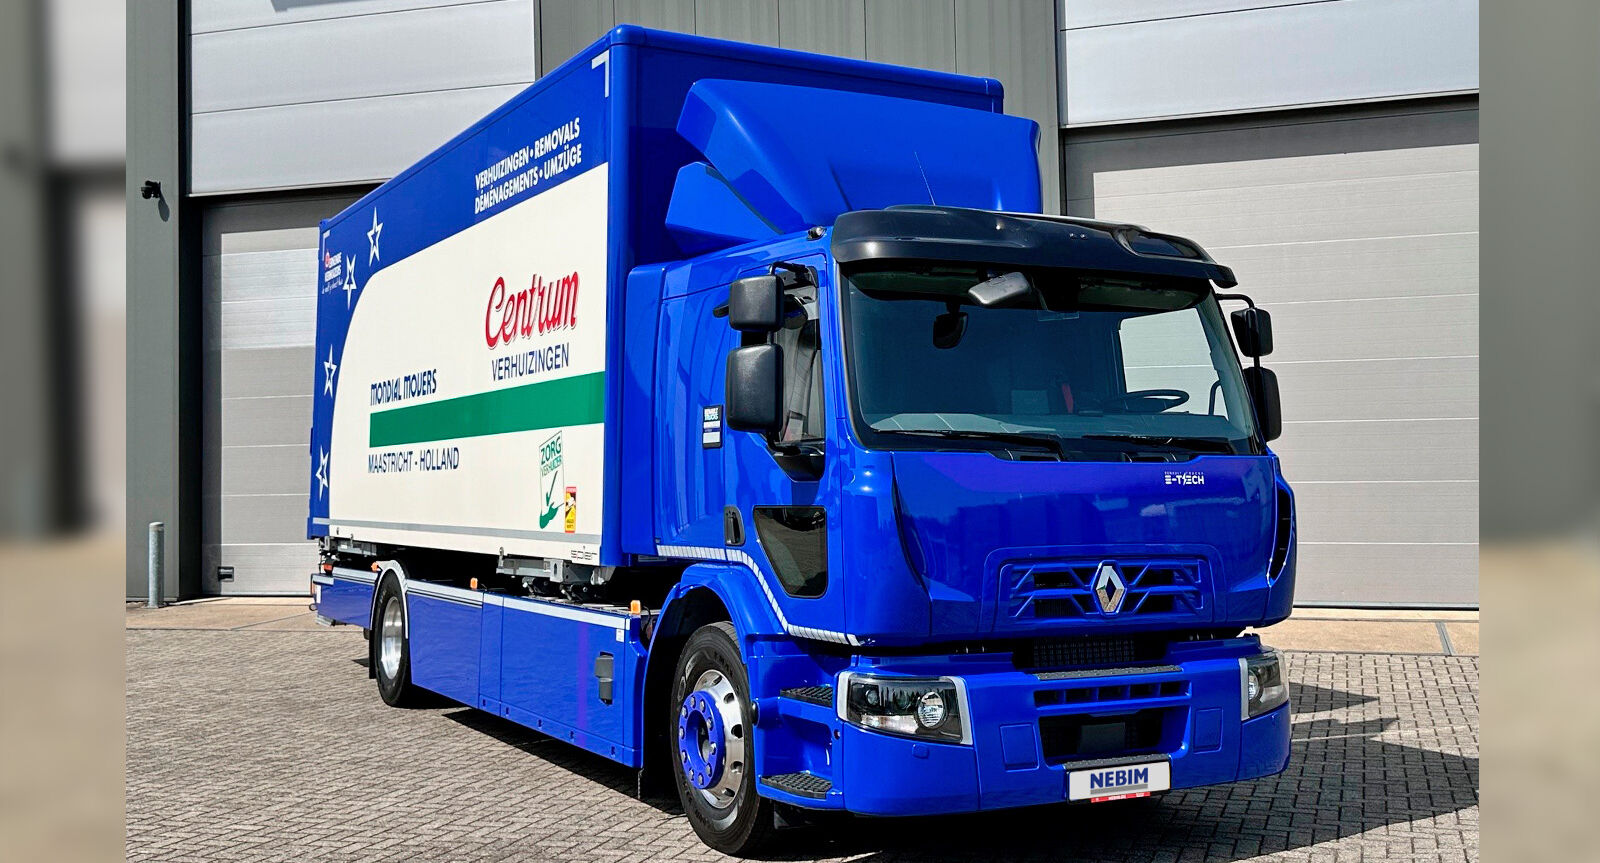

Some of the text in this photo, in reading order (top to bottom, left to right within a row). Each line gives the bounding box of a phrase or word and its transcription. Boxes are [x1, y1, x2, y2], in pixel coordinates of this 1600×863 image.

[475, 117, 580, 190] VERHUIZINGEN REMOVALS
[474, 143, 582, 214] DÉMÉNAGEMENTS UMZÜGE
[485, 271, 579, 350] Centrum
[491, 342, 570, 381] VERHUIZINGEN
[370, 377, 402, 406] MONDIAL
[368, 450, 413, 473] MAASTRICHT
[419, 447, 460, 471] HOLLAND
[540, 436, 561, 465] ZORG
[1164, 474, 1205, 485] E-TECH
[1090, 767, 1149, 789] NEBIM
